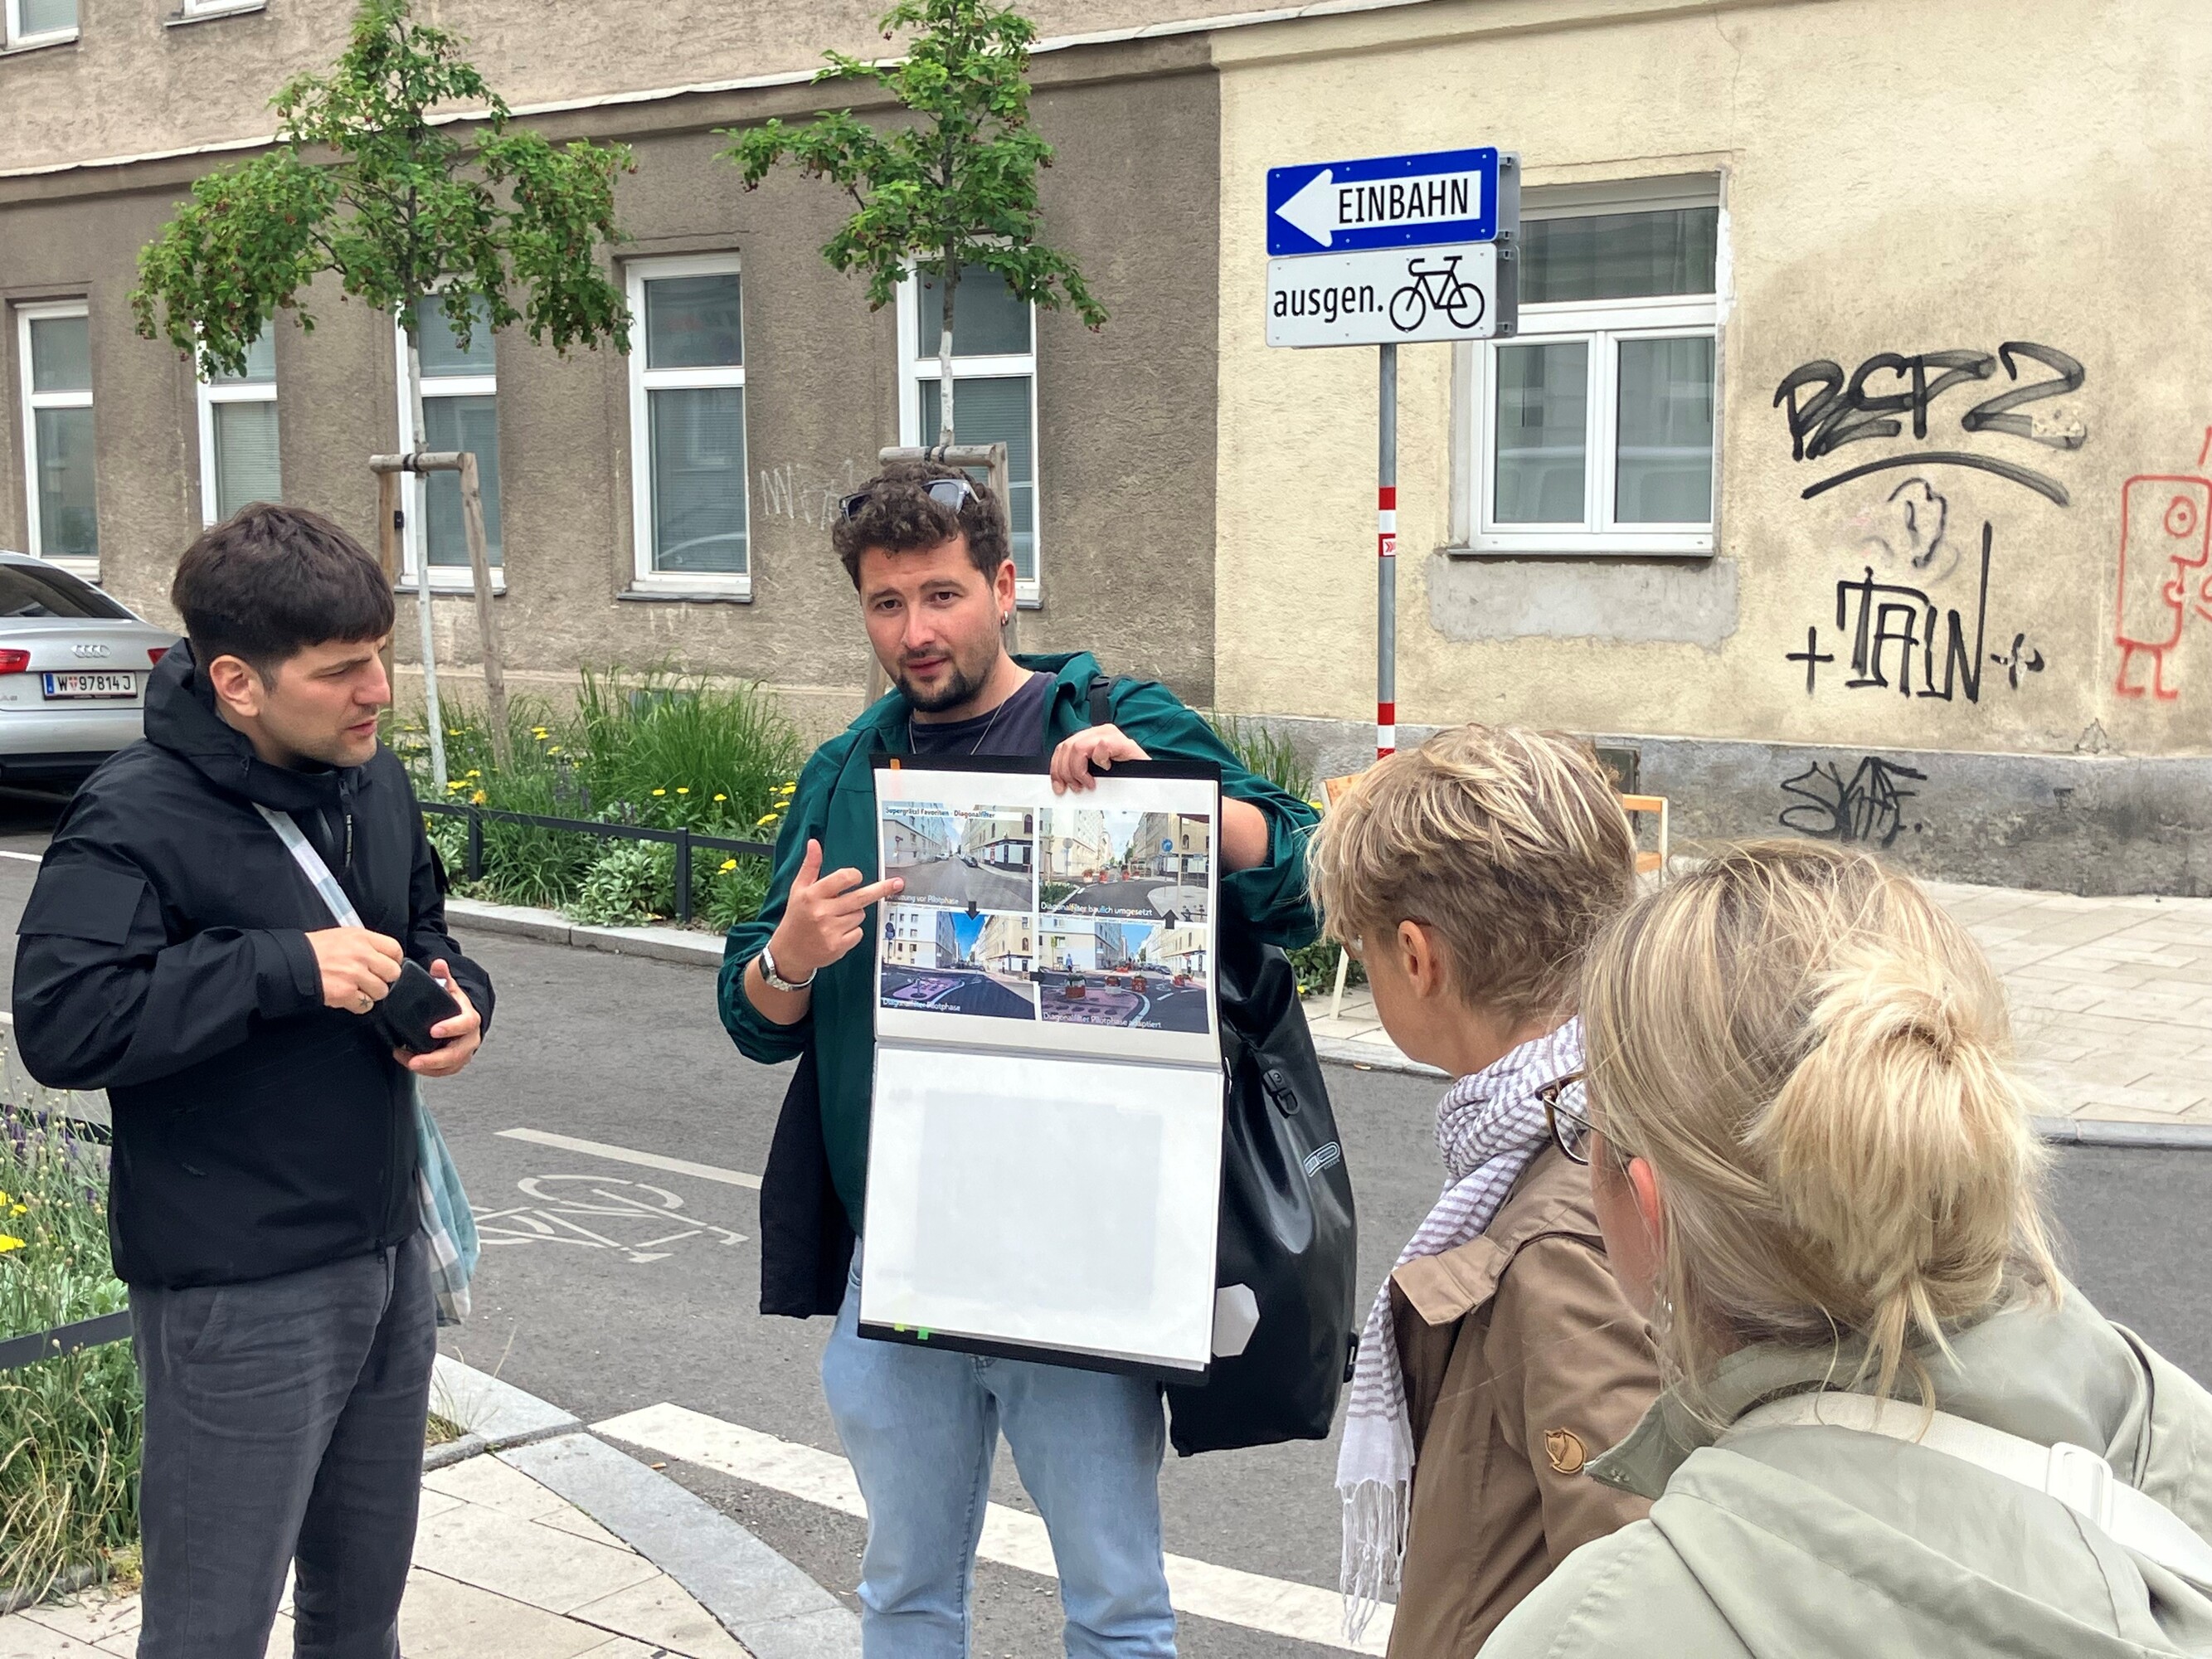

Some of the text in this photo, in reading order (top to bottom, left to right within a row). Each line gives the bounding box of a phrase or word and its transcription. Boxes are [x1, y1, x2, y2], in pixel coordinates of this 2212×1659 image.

[1338, 178, 1469, 224] EINBAHN
[1272, 285, 1384, 324] ausgen.
[57, 675, 68, 691] W
[954, 810, 995, 819] Diagonalfilter
[927, 895, 959, 905] Pilotphase
[1115, 907, 1153, 917] umgesetzt
[1091, 1015, 1128, 1026] Pilotphase
